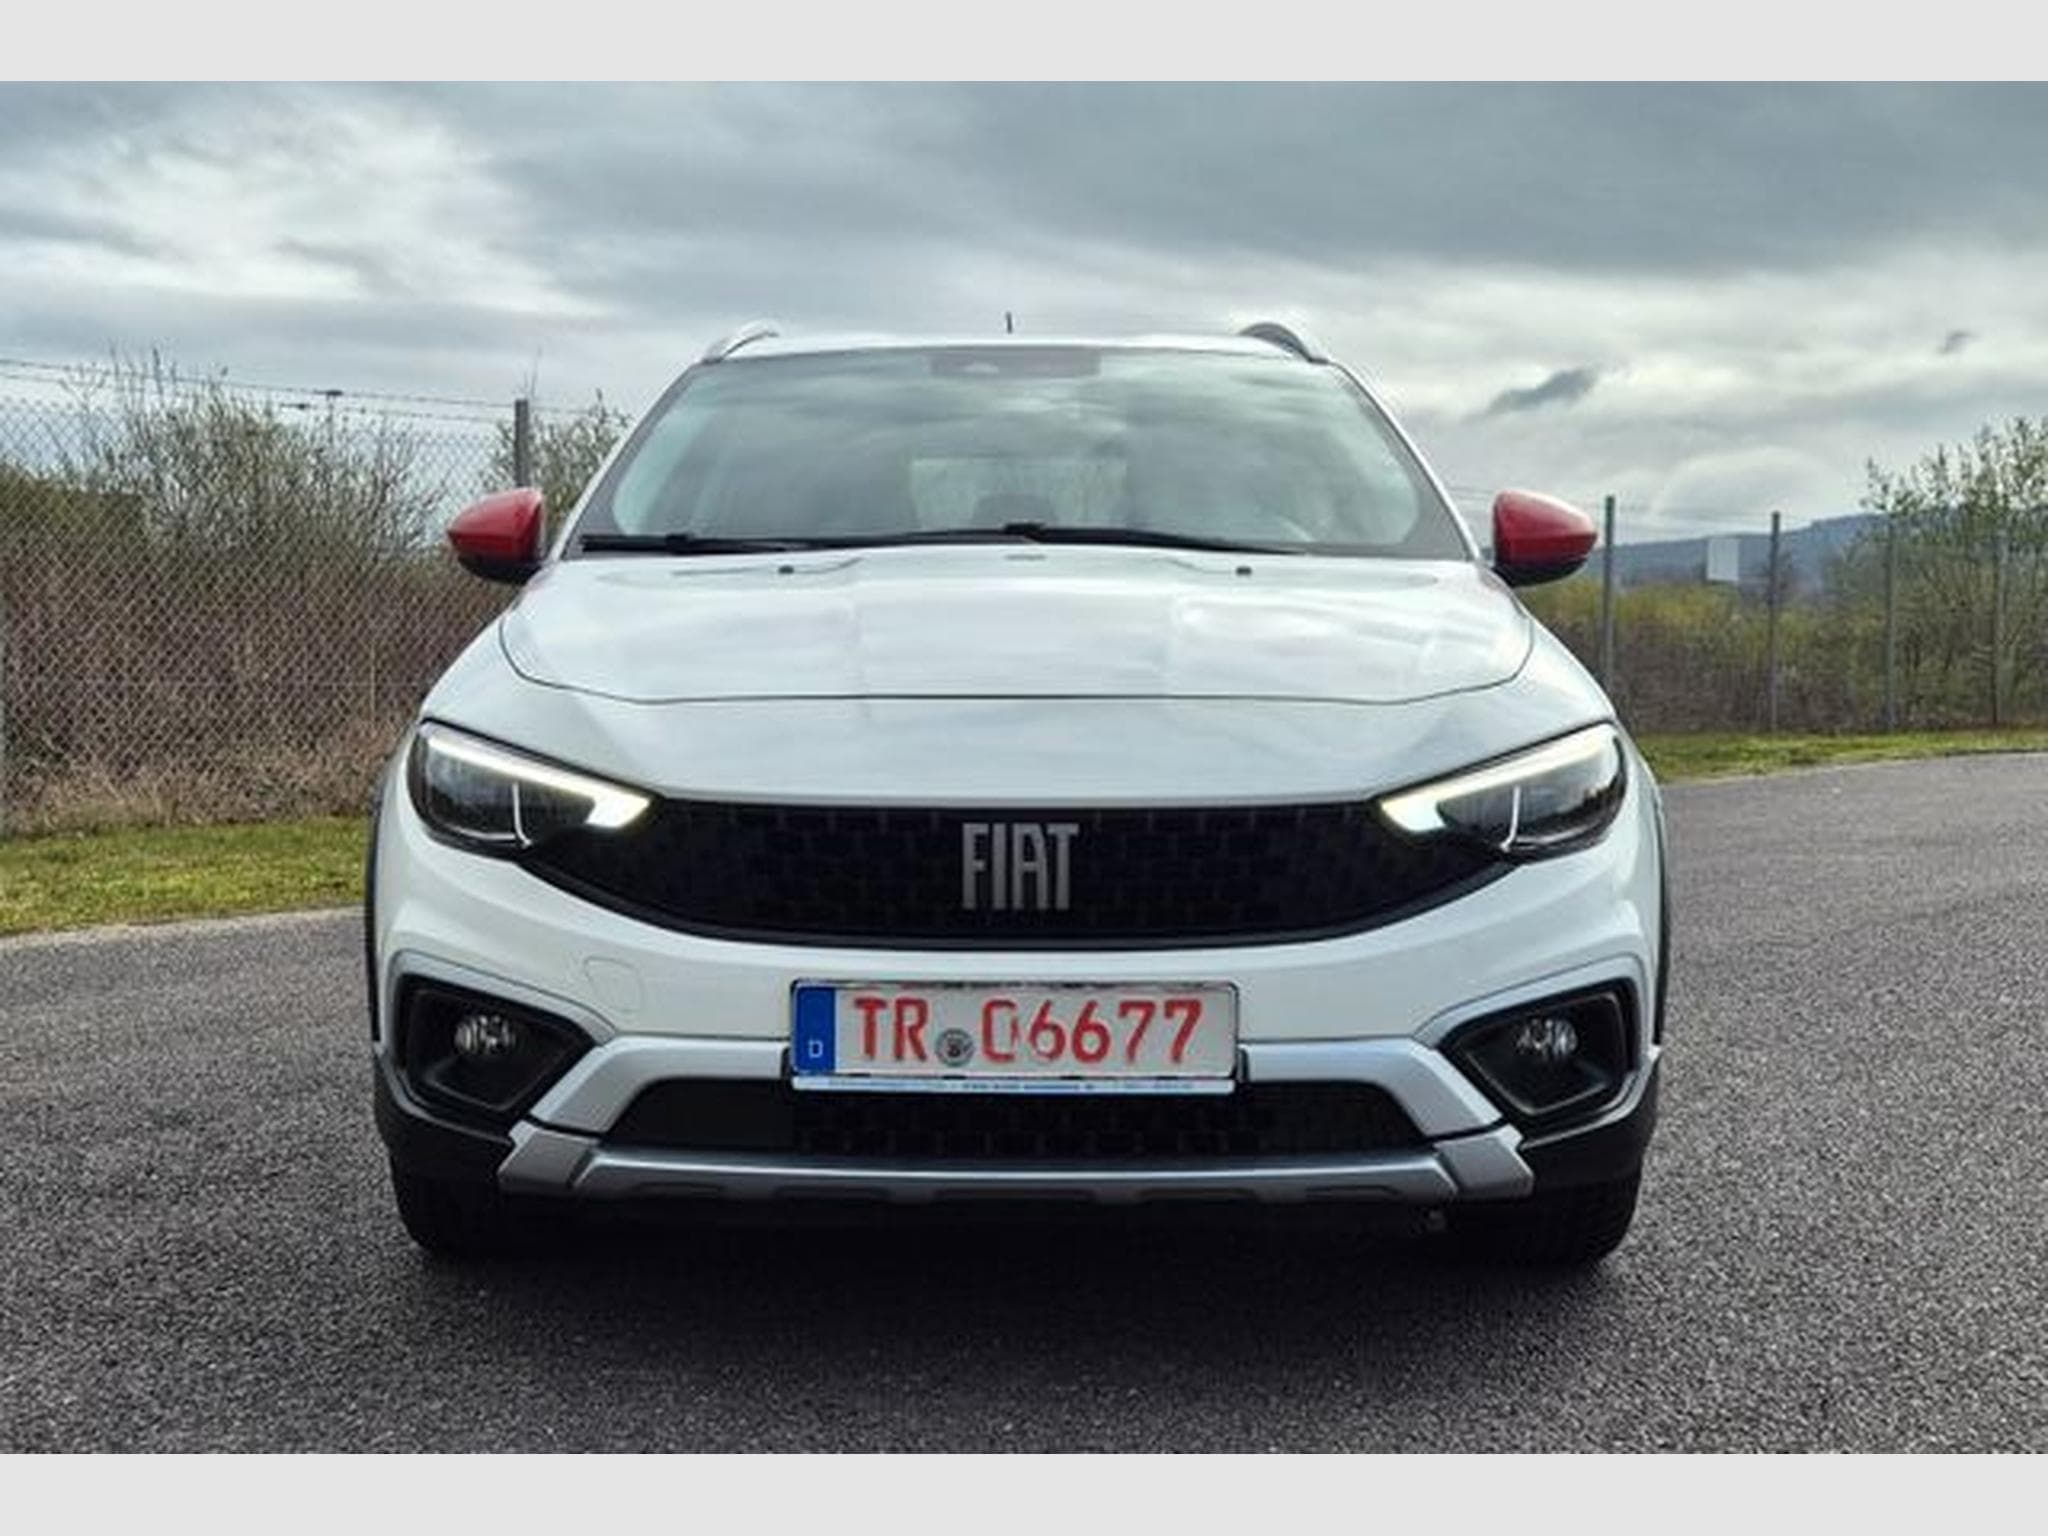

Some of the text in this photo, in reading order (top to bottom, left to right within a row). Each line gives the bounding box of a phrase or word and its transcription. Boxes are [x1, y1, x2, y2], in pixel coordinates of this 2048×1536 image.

[962, 822, 1079, 910] FIAT
[808, 1040, 825, 1059] D
[853, 998, 1204, 1064] TR 06677
